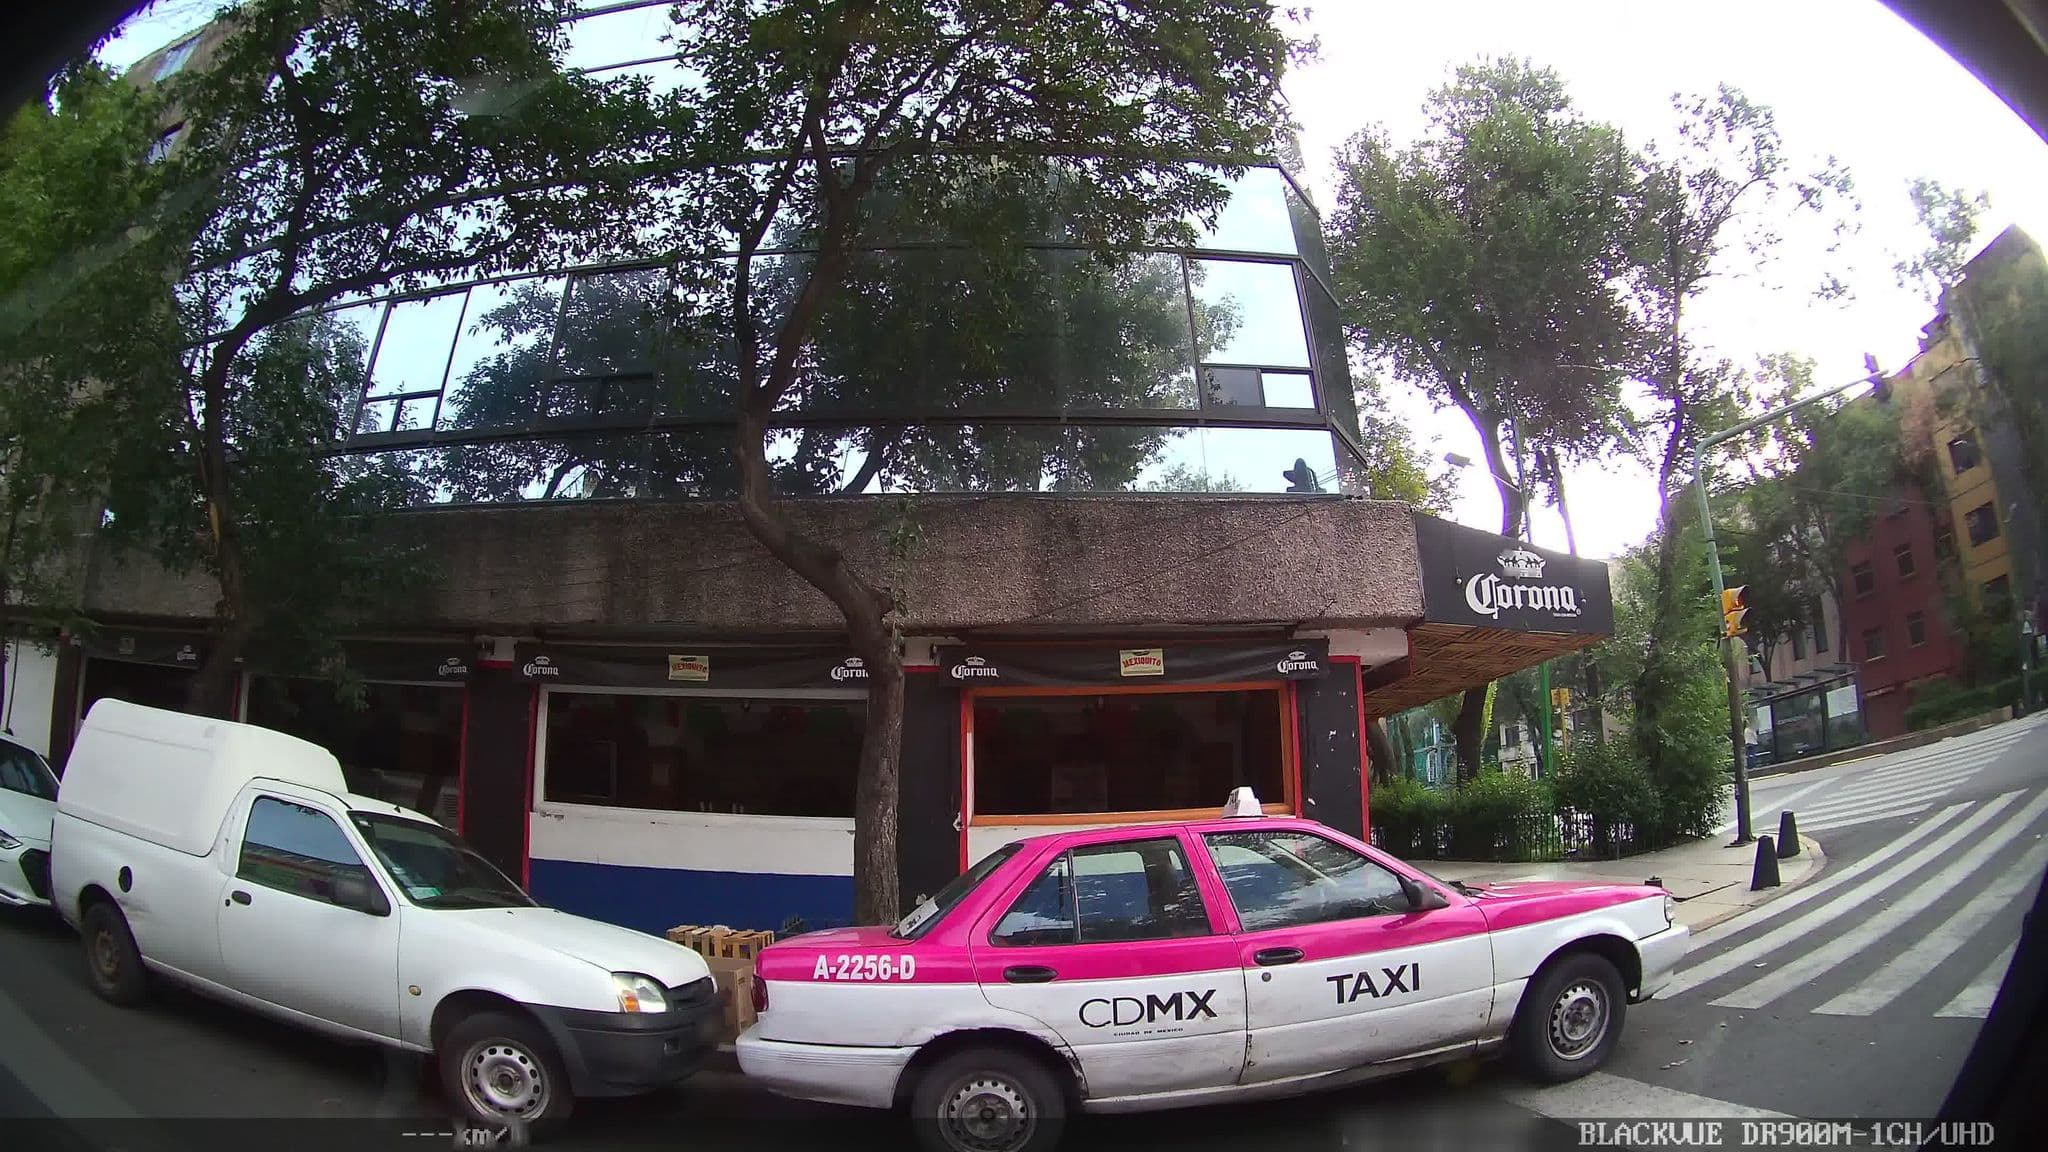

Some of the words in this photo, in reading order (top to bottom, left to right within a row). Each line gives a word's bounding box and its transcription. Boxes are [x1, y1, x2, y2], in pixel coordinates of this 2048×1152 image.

[1465, 572, 1577, 620] Corona
[438, 664, 467, 676] Corona
[523, 663, 559, 677] Corona
[1122, 656, 1161, 668] MEXIQUITO
[1277, 659, 1319, 675] Corona
[830, 665, 869, 682] Coron
[951, 664, 1000, 681] Corona
[813, 954, 916, 980] A-2256-D
[1326, 962, 1420, 1004] TAXI
[1079, 989, 1217, 1028] CDMX
